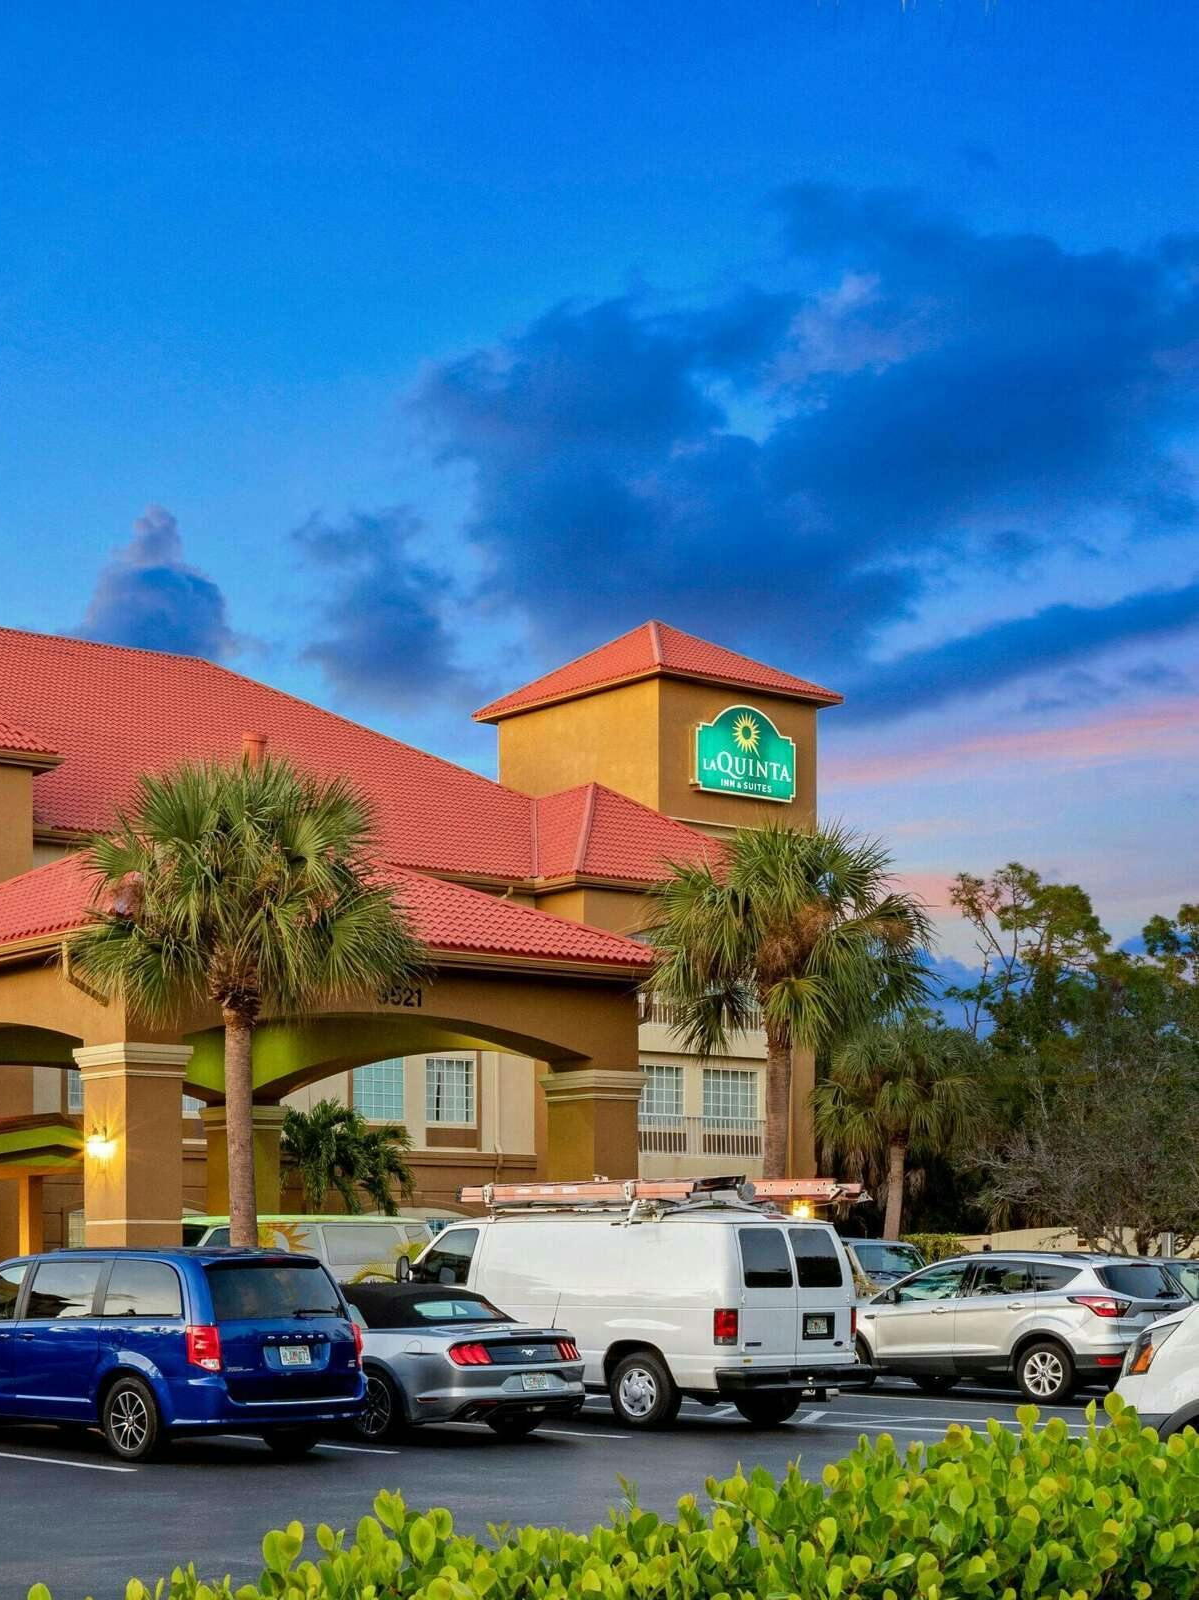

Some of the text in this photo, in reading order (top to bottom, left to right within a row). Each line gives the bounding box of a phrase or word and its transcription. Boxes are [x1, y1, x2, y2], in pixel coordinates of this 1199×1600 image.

[703, 751, 792, 783] LA QUINTA
[720, 778, 772, 793] INN & SUITES
